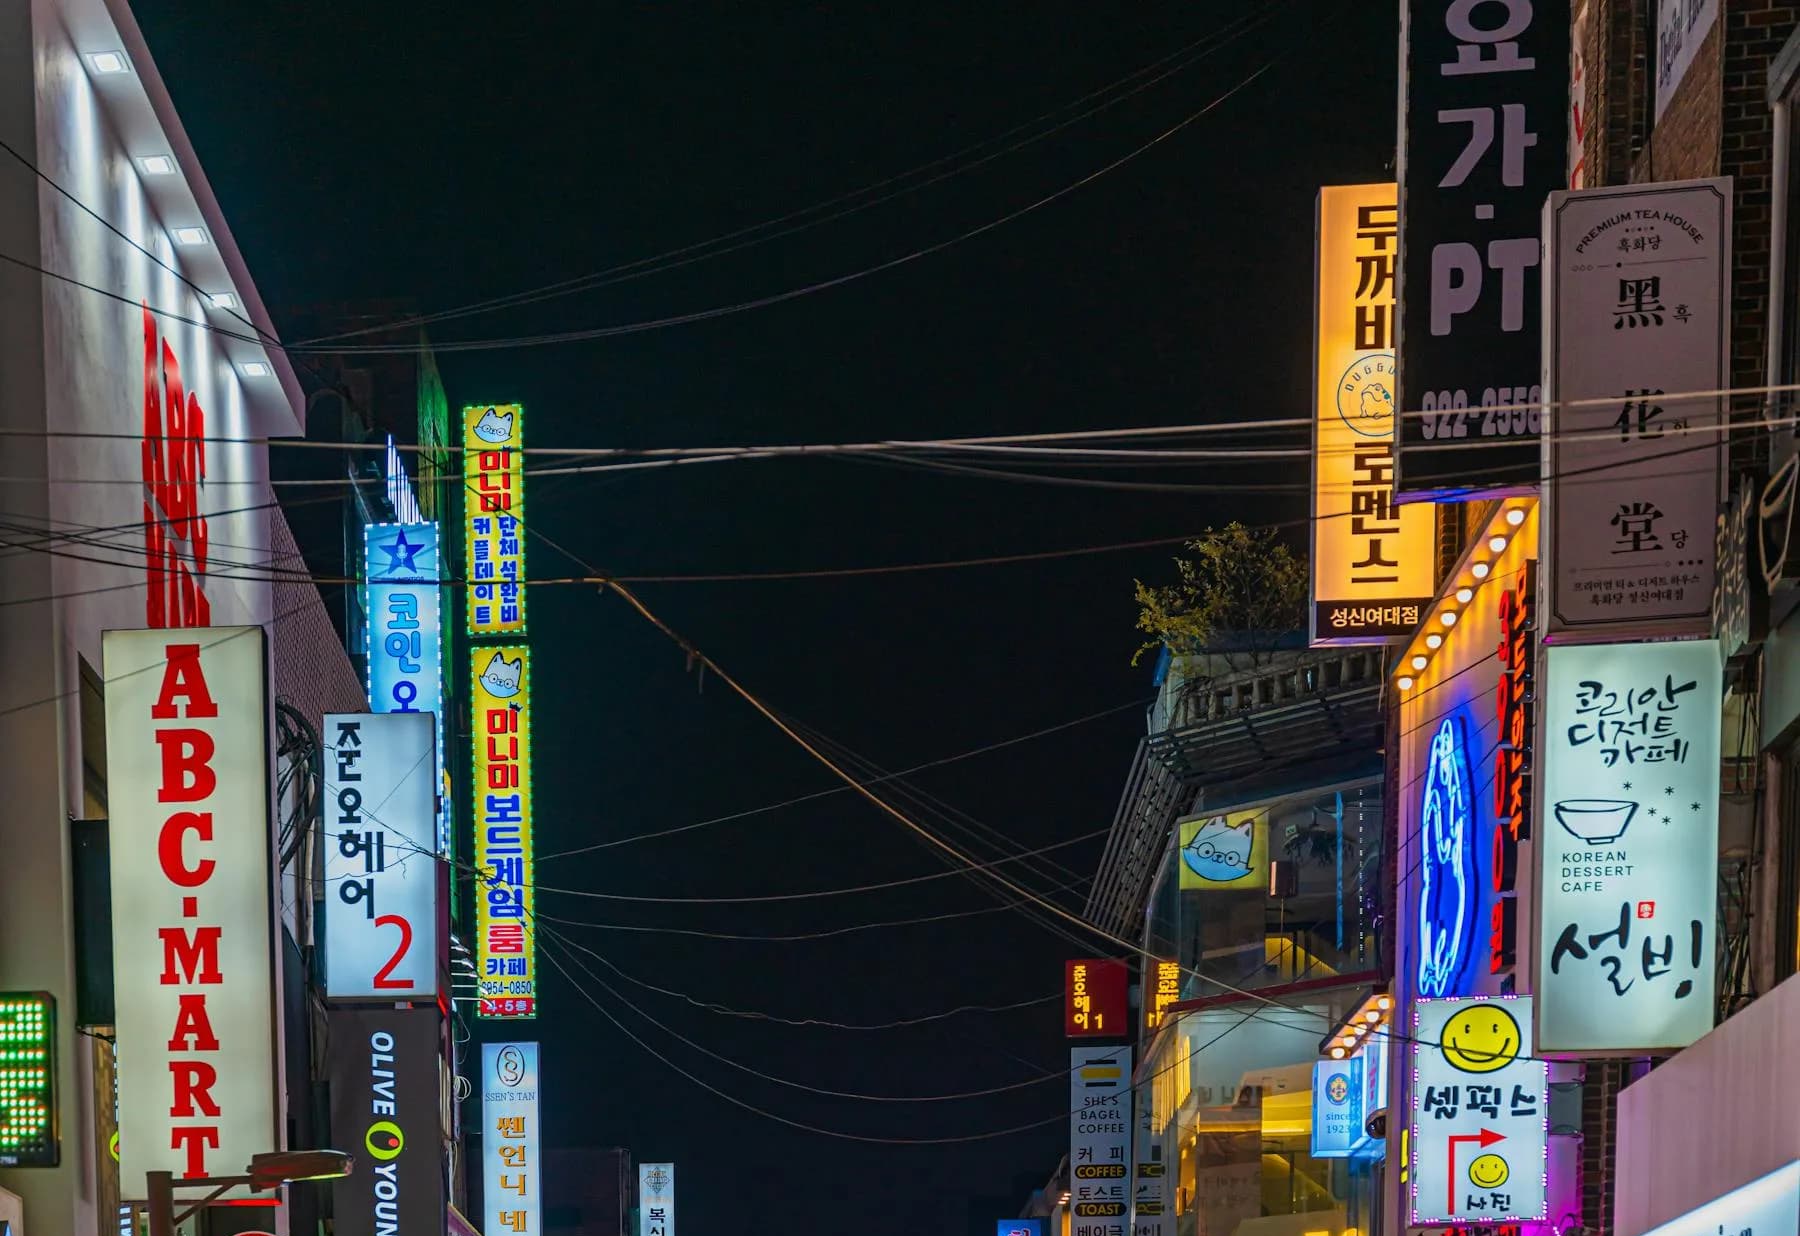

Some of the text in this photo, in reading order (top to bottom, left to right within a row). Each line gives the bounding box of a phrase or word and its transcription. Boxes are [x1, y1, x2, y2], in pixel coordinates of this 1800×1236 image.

[1439, 0, 1537, 188] 요가
[1576, 210, 1704, 253] PREMIUM TEA HOUSE
[1617, 234, 1661, 252] 흑화당
[1355, 205, 1398, 350] 두꺼비
[1431, 238, 1540, 336] PT
[1422, 385, 1541, 439] 922-2558
[480, 449, 511, 512] 미니미
[1330, 606, 1419, 628] 성신여대점
[387, 594, 420, 673] 코인
[1576, 675, 1697, 717] 코리안
[1567, 712, 1677, 746] 디저트
[487, 708, 519, 789] 미니미
[1600, 738, 1688, 768] 카페
[337, 722, 384, 919] 준오헤어
[485, 794, 523, 917] 보드게임
[1562, 851, 1626, 863] KOREAN
[1562, 866, 1634, 878] DESSERT
[1562, 881, 1603, 892] CAFE
[151, 644, 222, 1178] ABC-MART
[488, 925, 524, 953] 룸
[373, 914, 414, 989] 2
[486, 958, 526, 976] 카페
[1094, 1013, 1103, 1029] 1
[371, 1031, 396, 1116] OLIVE
[485, 1091, 535, 1101] SSEN'S TAN
[1084, 1096, 1119, 1106] SHE'S
[1080, 1110, 1120, 1119] BAGEL
[1326, 1112, 1351, 1121] since
[1078, 1123, 1124, 1133] COFFEE
[1327, 1125, 1351, 1134] 1923
[1078, 1146, 1124, 1162] 커피
[1076, 1167, 1124, 1177] COFFEE
[1078, 1186, 1124, 1201] 토스트
[1467, 1193, 1511, 1211] 사진
[1080, 1204, 1121, 1215] TOAST
